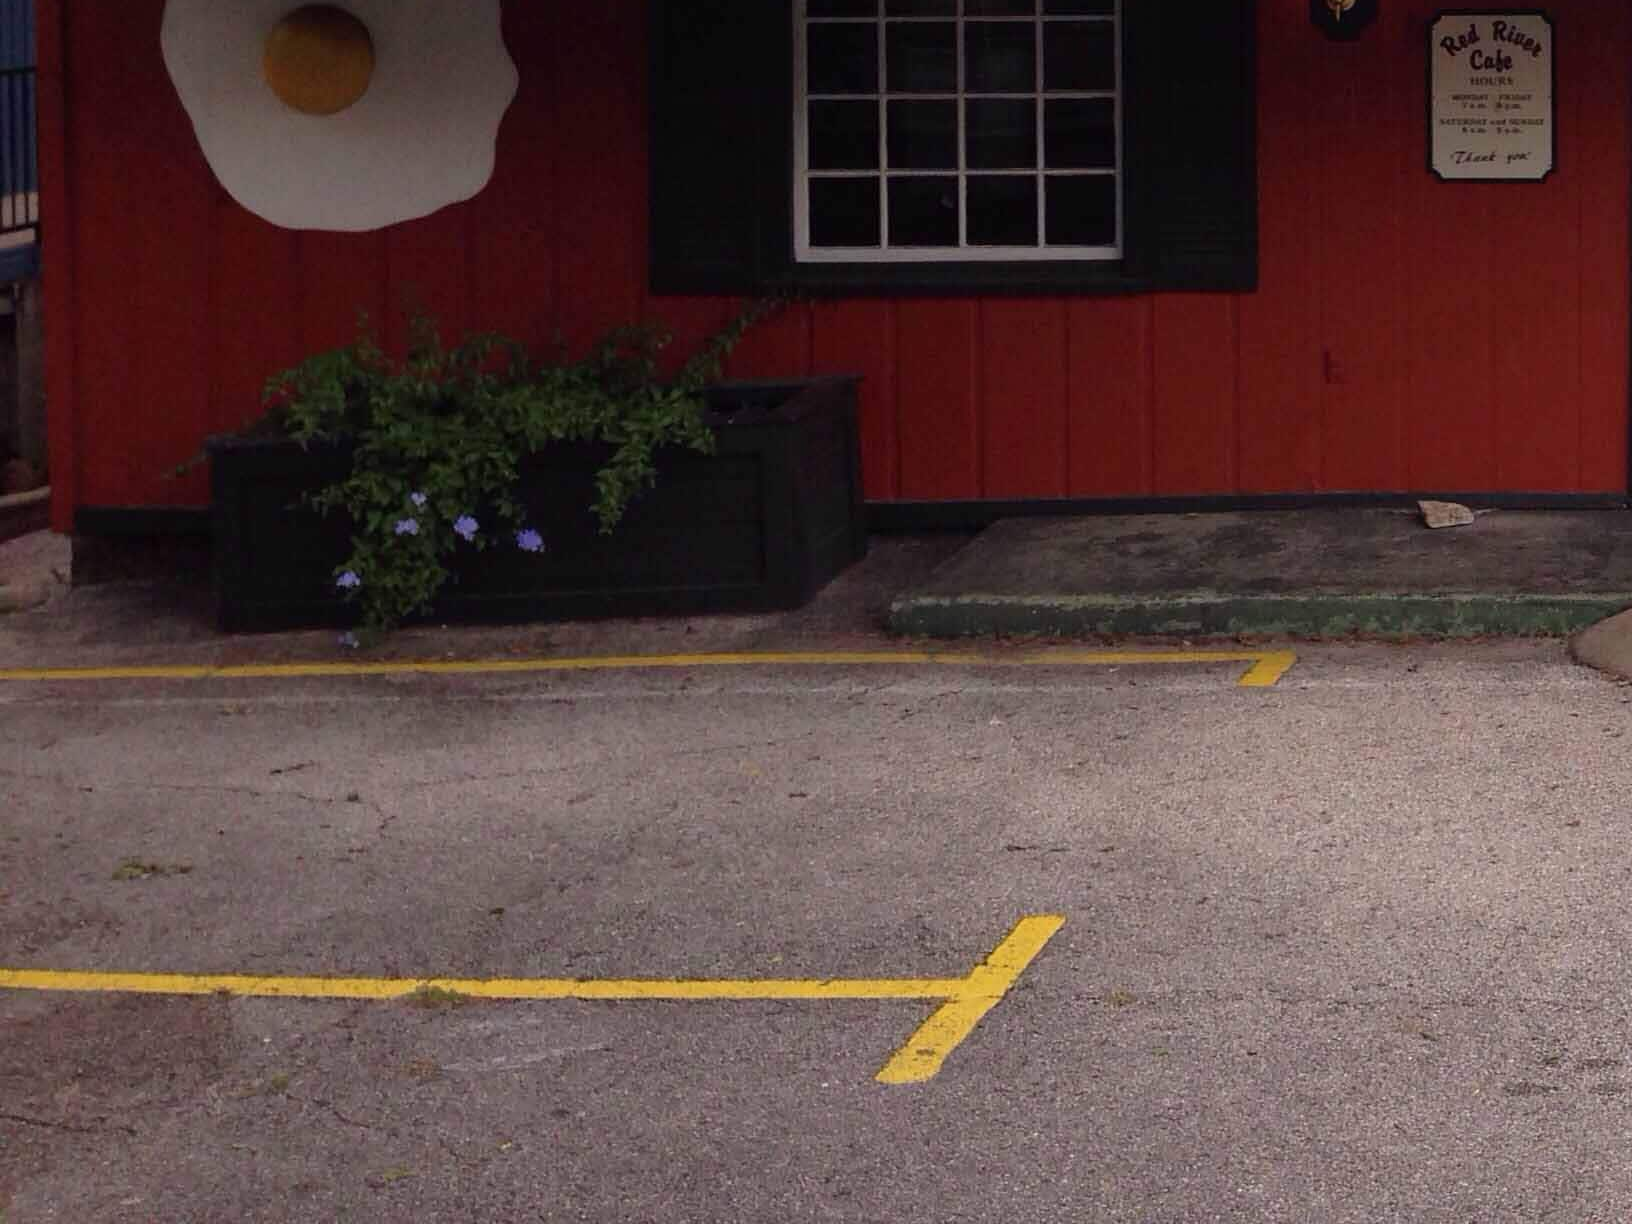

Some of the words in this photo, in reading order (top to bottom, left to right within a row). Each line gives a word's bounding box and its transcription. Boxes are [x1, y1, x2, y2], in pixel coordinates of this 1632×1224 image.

[1440, 23, 1480, 57] Red
[1492, 20, 1542, 57] River
[1470, 49, 1513, 72] Cafe
[1470, 76, 1514, 86] HOURS
